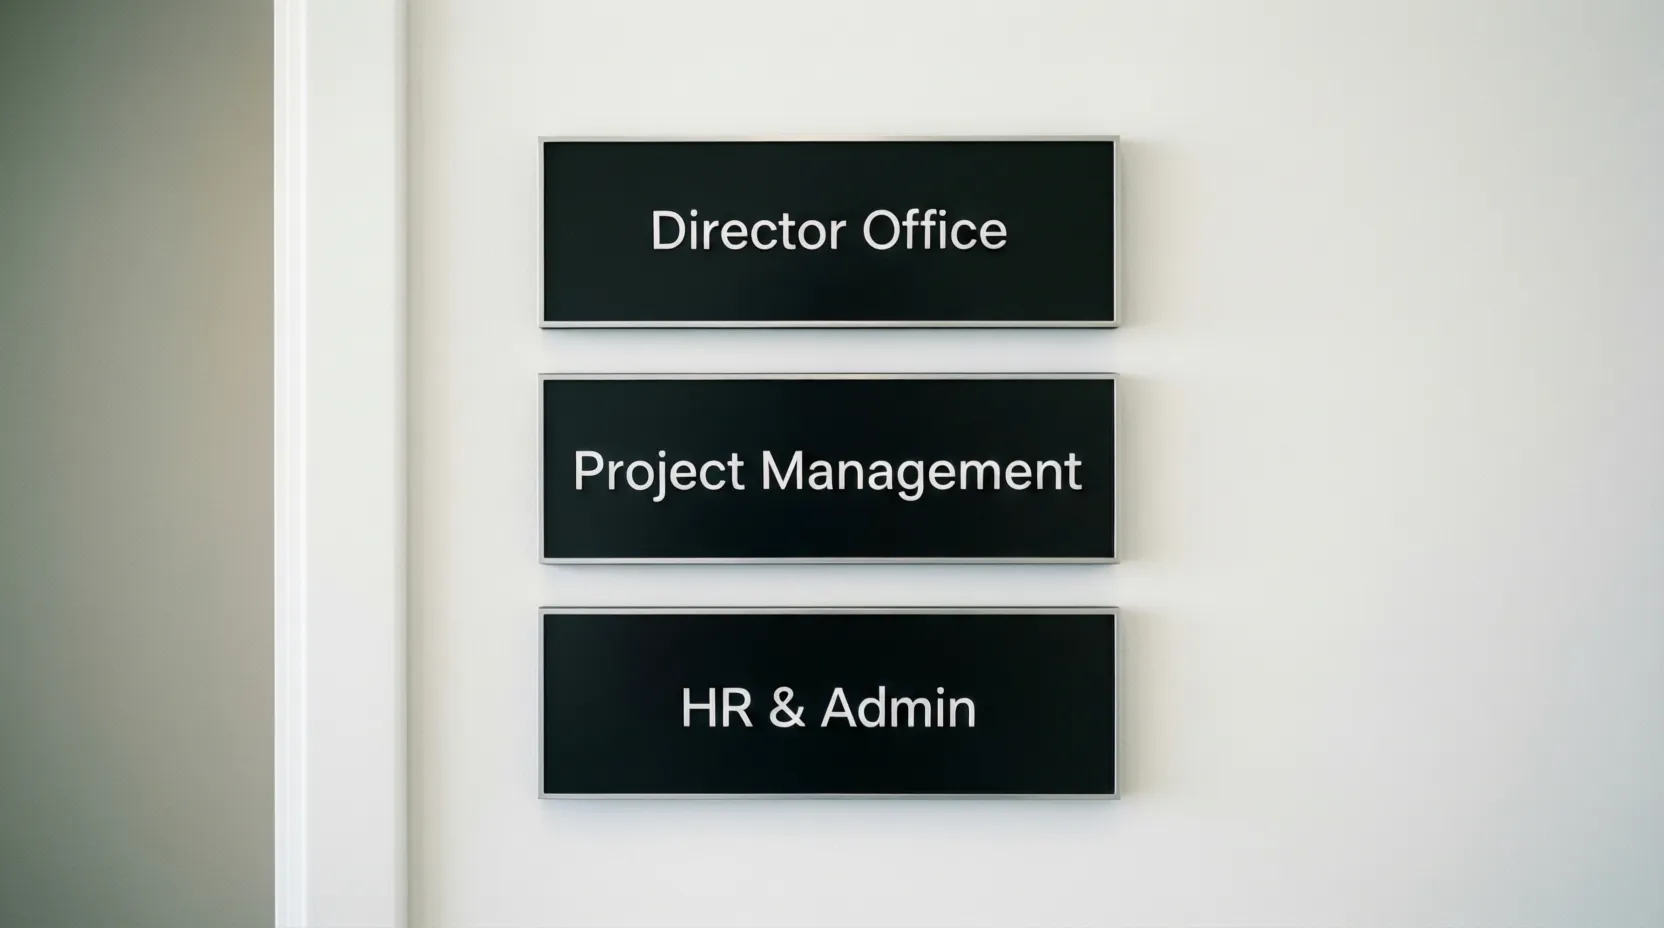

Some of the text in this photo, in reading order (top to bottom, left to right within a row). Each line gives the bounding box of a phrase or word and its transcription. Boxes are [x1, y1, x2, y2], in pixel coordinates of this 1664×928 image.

[652, 207, 1007, 251] Director Office
[575, 449, 1083, 503] Project Management
[683, 685, 976, 728] HR & Admin
